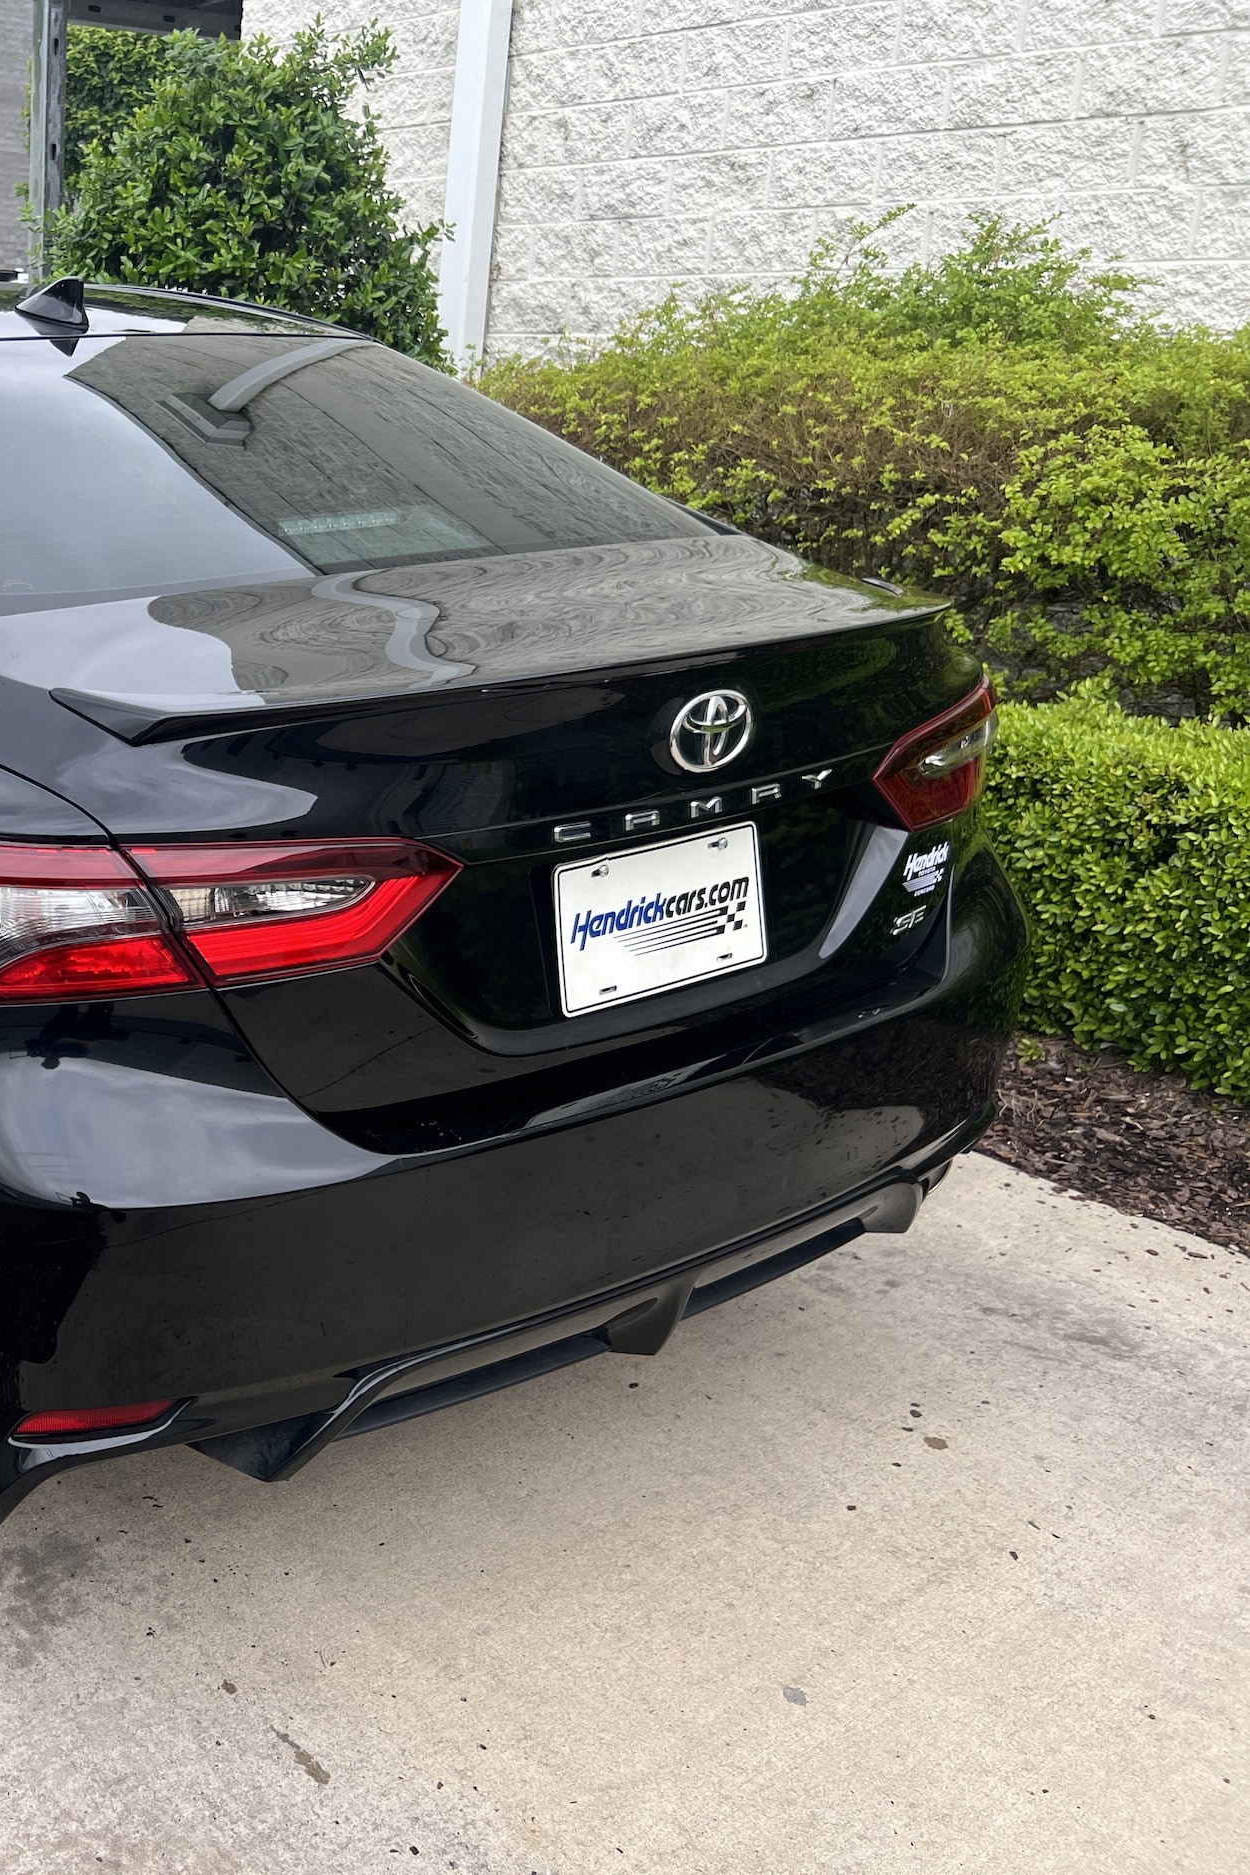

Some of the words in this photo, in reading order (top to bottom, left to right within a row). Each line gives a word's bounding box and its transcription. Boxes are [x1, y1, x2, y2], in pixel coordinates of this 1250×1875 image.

[553, 768, 833, 844] CAMRY
[902, 841, 950, 881] Hendrick
[570, 876, 750, 952] Hendrickcars.com
[891, 905, 927, 935] SE
